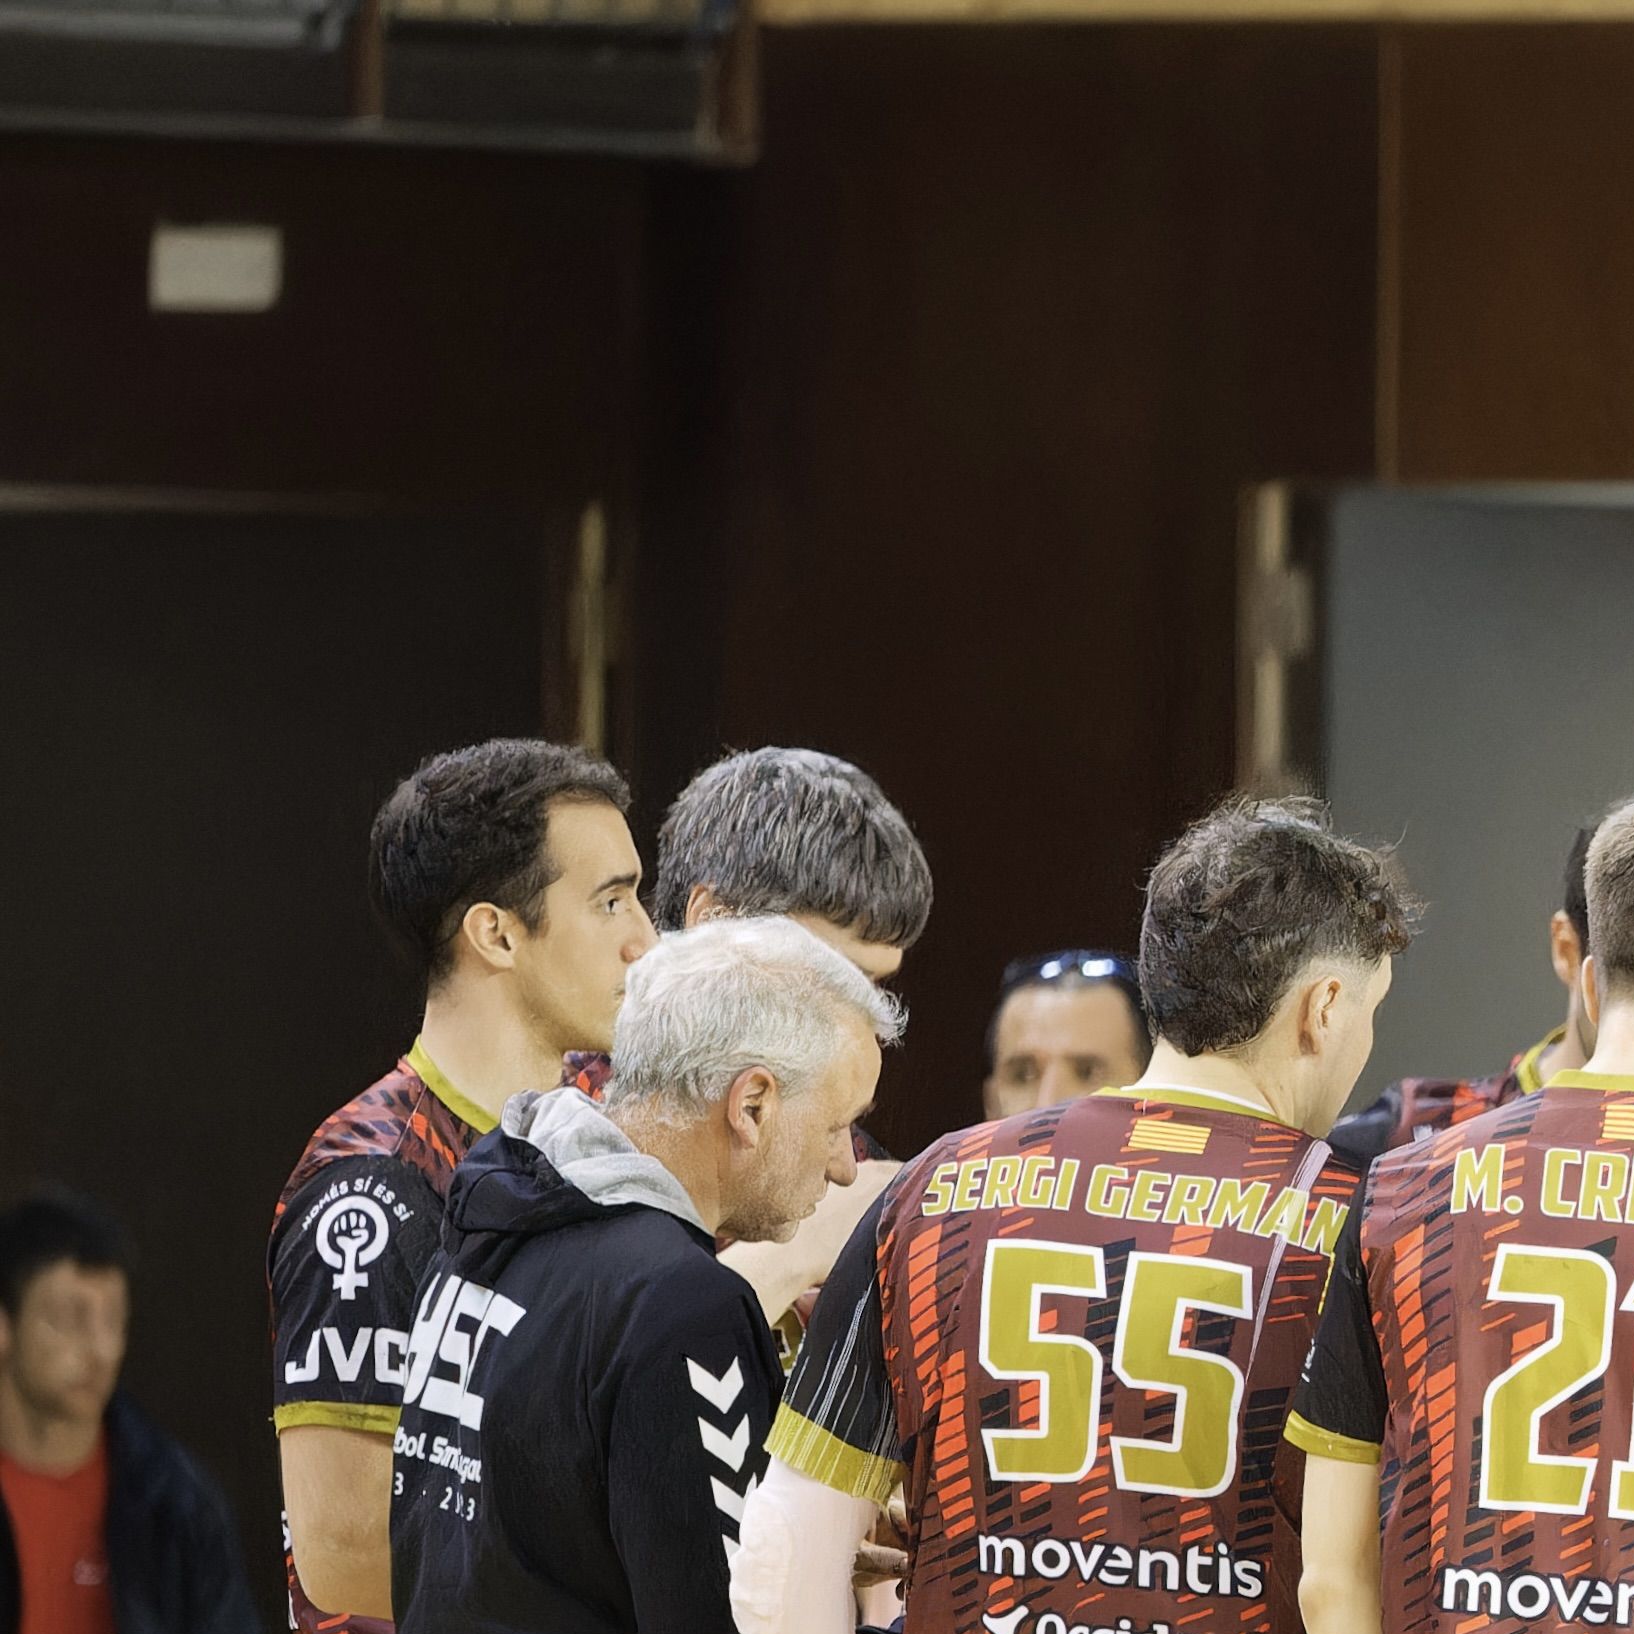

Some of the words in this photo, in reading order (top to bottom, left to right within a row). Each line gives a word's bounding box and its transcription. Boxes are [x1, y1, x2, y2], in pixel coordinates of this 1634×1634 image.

[922, 1155, 1080, 1217] SERGI
[1450, 1147, 1522, 1216] M.
[284, 1326, 410, 1386] JVC
[978, 1237, 1254, 1499] 55
[393, 1426, 426, 1461] bol
[978, 1534, 1263, 1599] moventis
